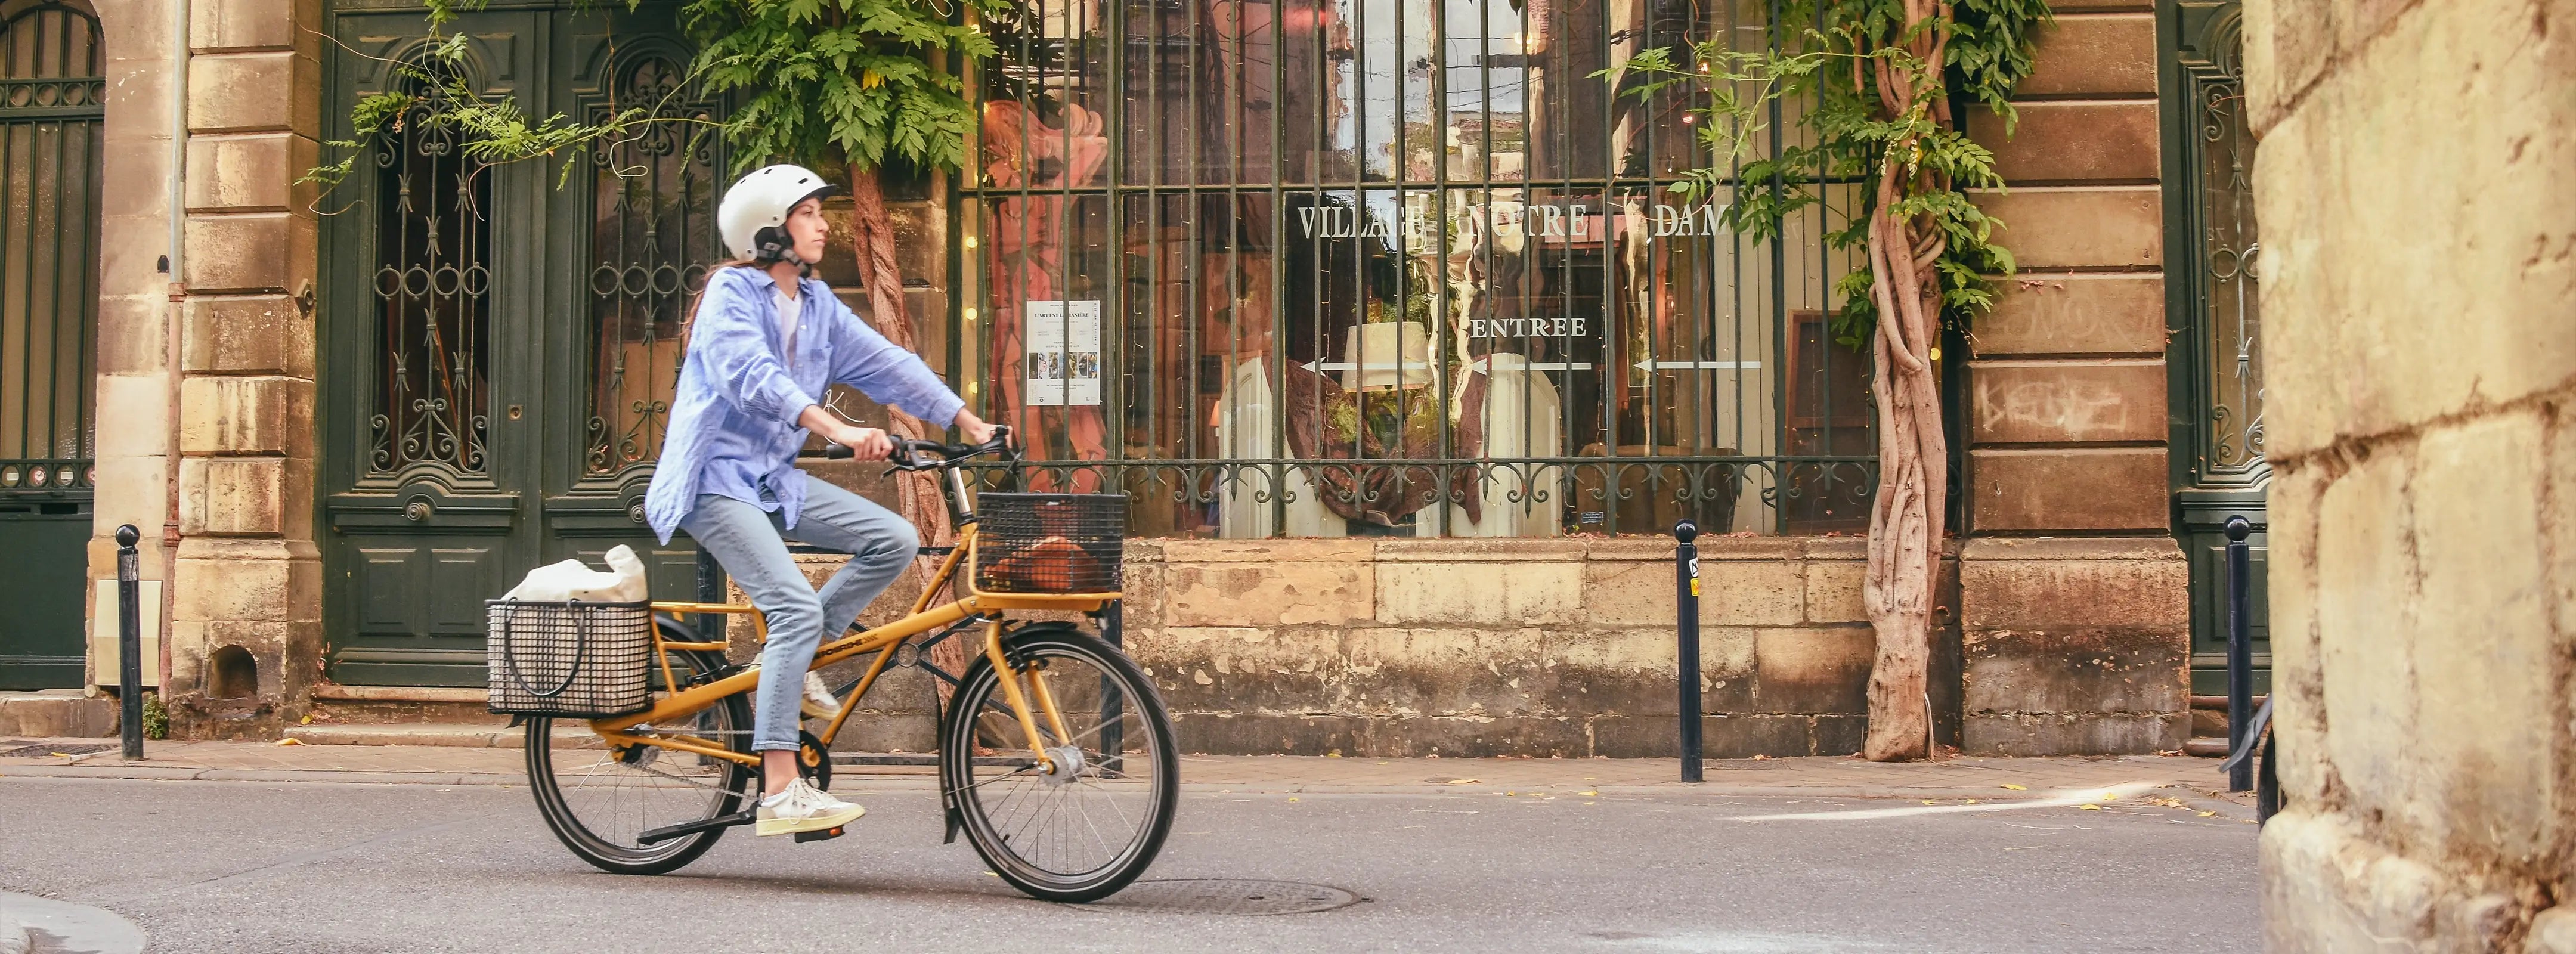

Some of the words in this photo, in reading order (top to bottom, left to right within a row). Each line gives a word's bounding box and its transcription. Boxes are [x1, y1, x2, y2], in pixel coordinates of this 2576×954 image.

[1298, 206, 1425, 238] VILLAGE
[1466, 205, 1588, 237] NOTRE
[1655, 204, 1754, 236] DAM
[1470, 318, 1587, 338] ENTREE
